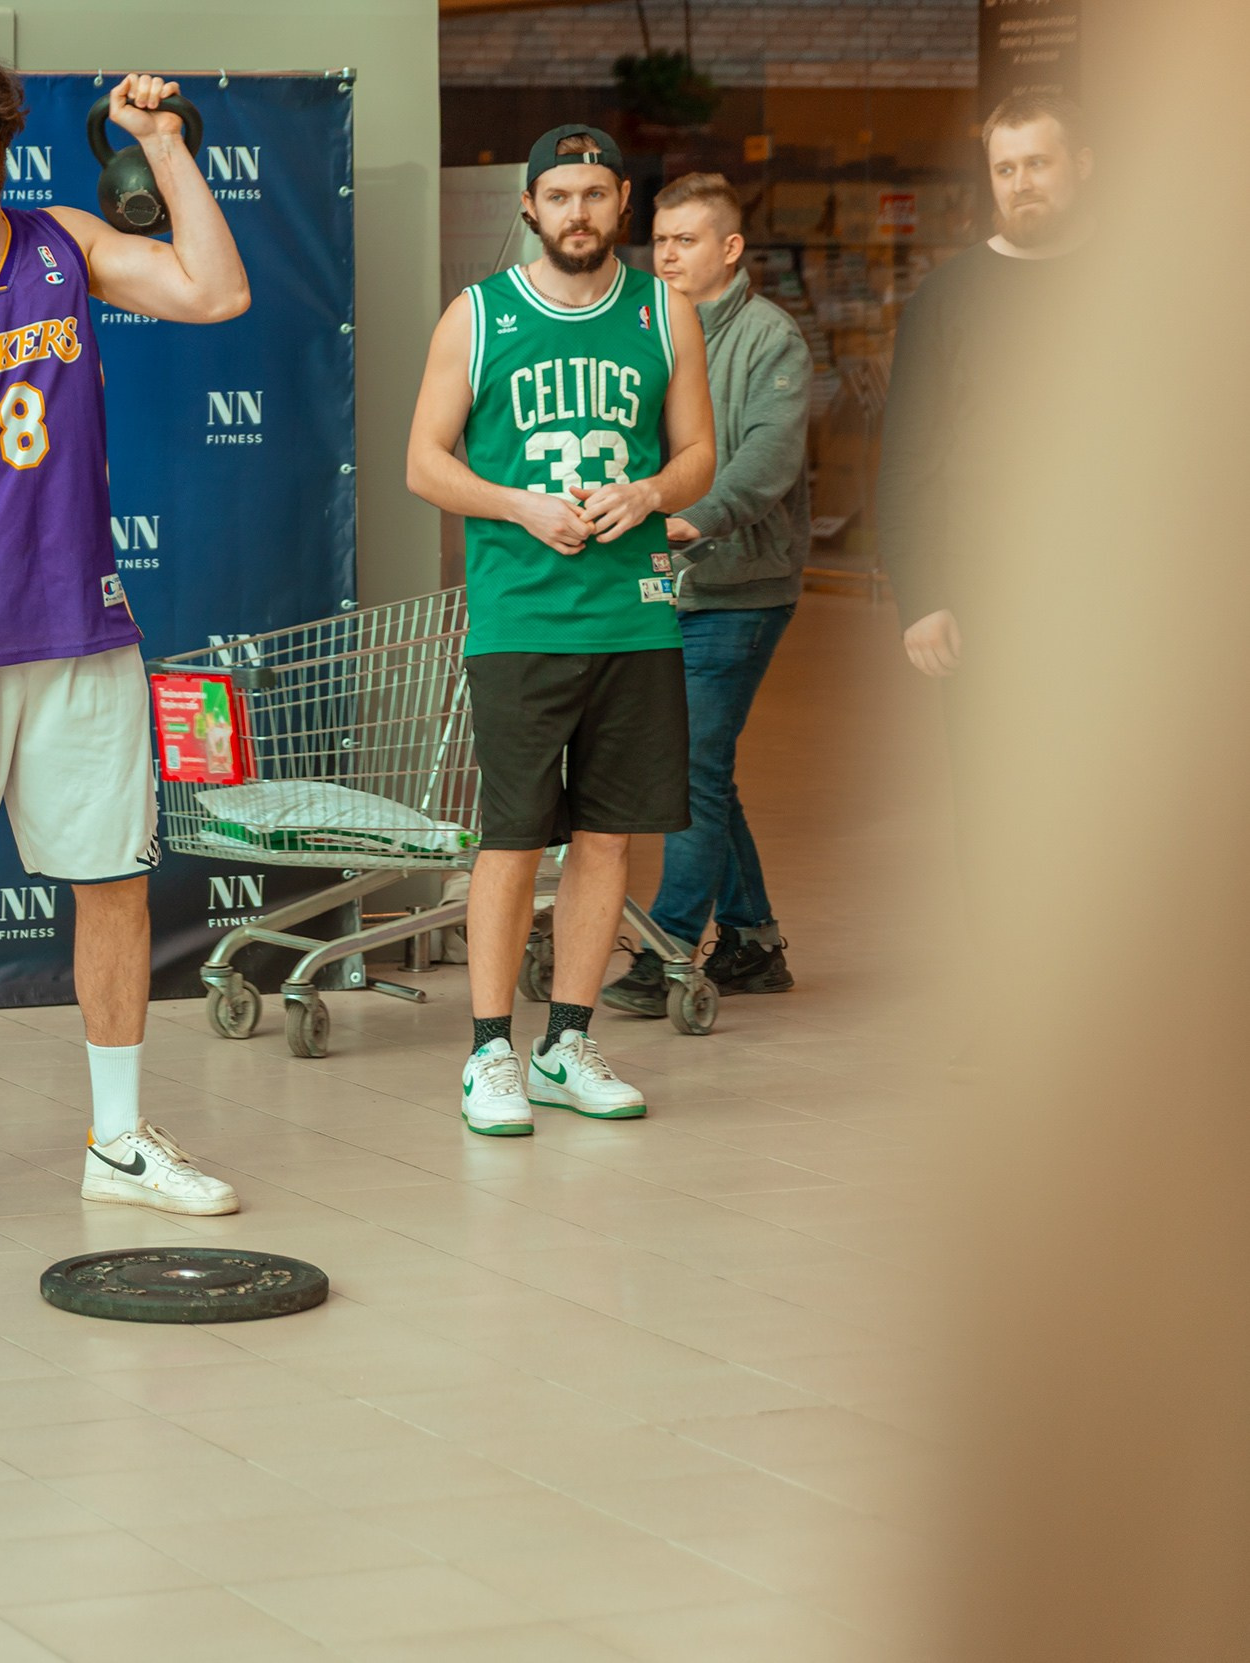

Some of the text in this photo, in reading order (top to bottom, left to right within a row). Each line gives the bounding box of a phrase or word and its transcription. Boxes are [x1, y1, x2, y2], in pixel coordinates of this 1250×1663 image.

[206, 145, 261, 181] NN
[3, 189, 53, 200] ITNESS
[213, 188, 262, 200] ITNESS
[206, 390, 263, 426] NN
[510, 357, 642, 431] CELTICS
[206, 433, 263, 445] FITNESS
[525, 429, 631, 505] 33
[110, 514, 161, 550] NN
[116, 558, 160, 569] TNESS
[207, 633, 265, 668] NN
[207, 873, 266, 910] NN
